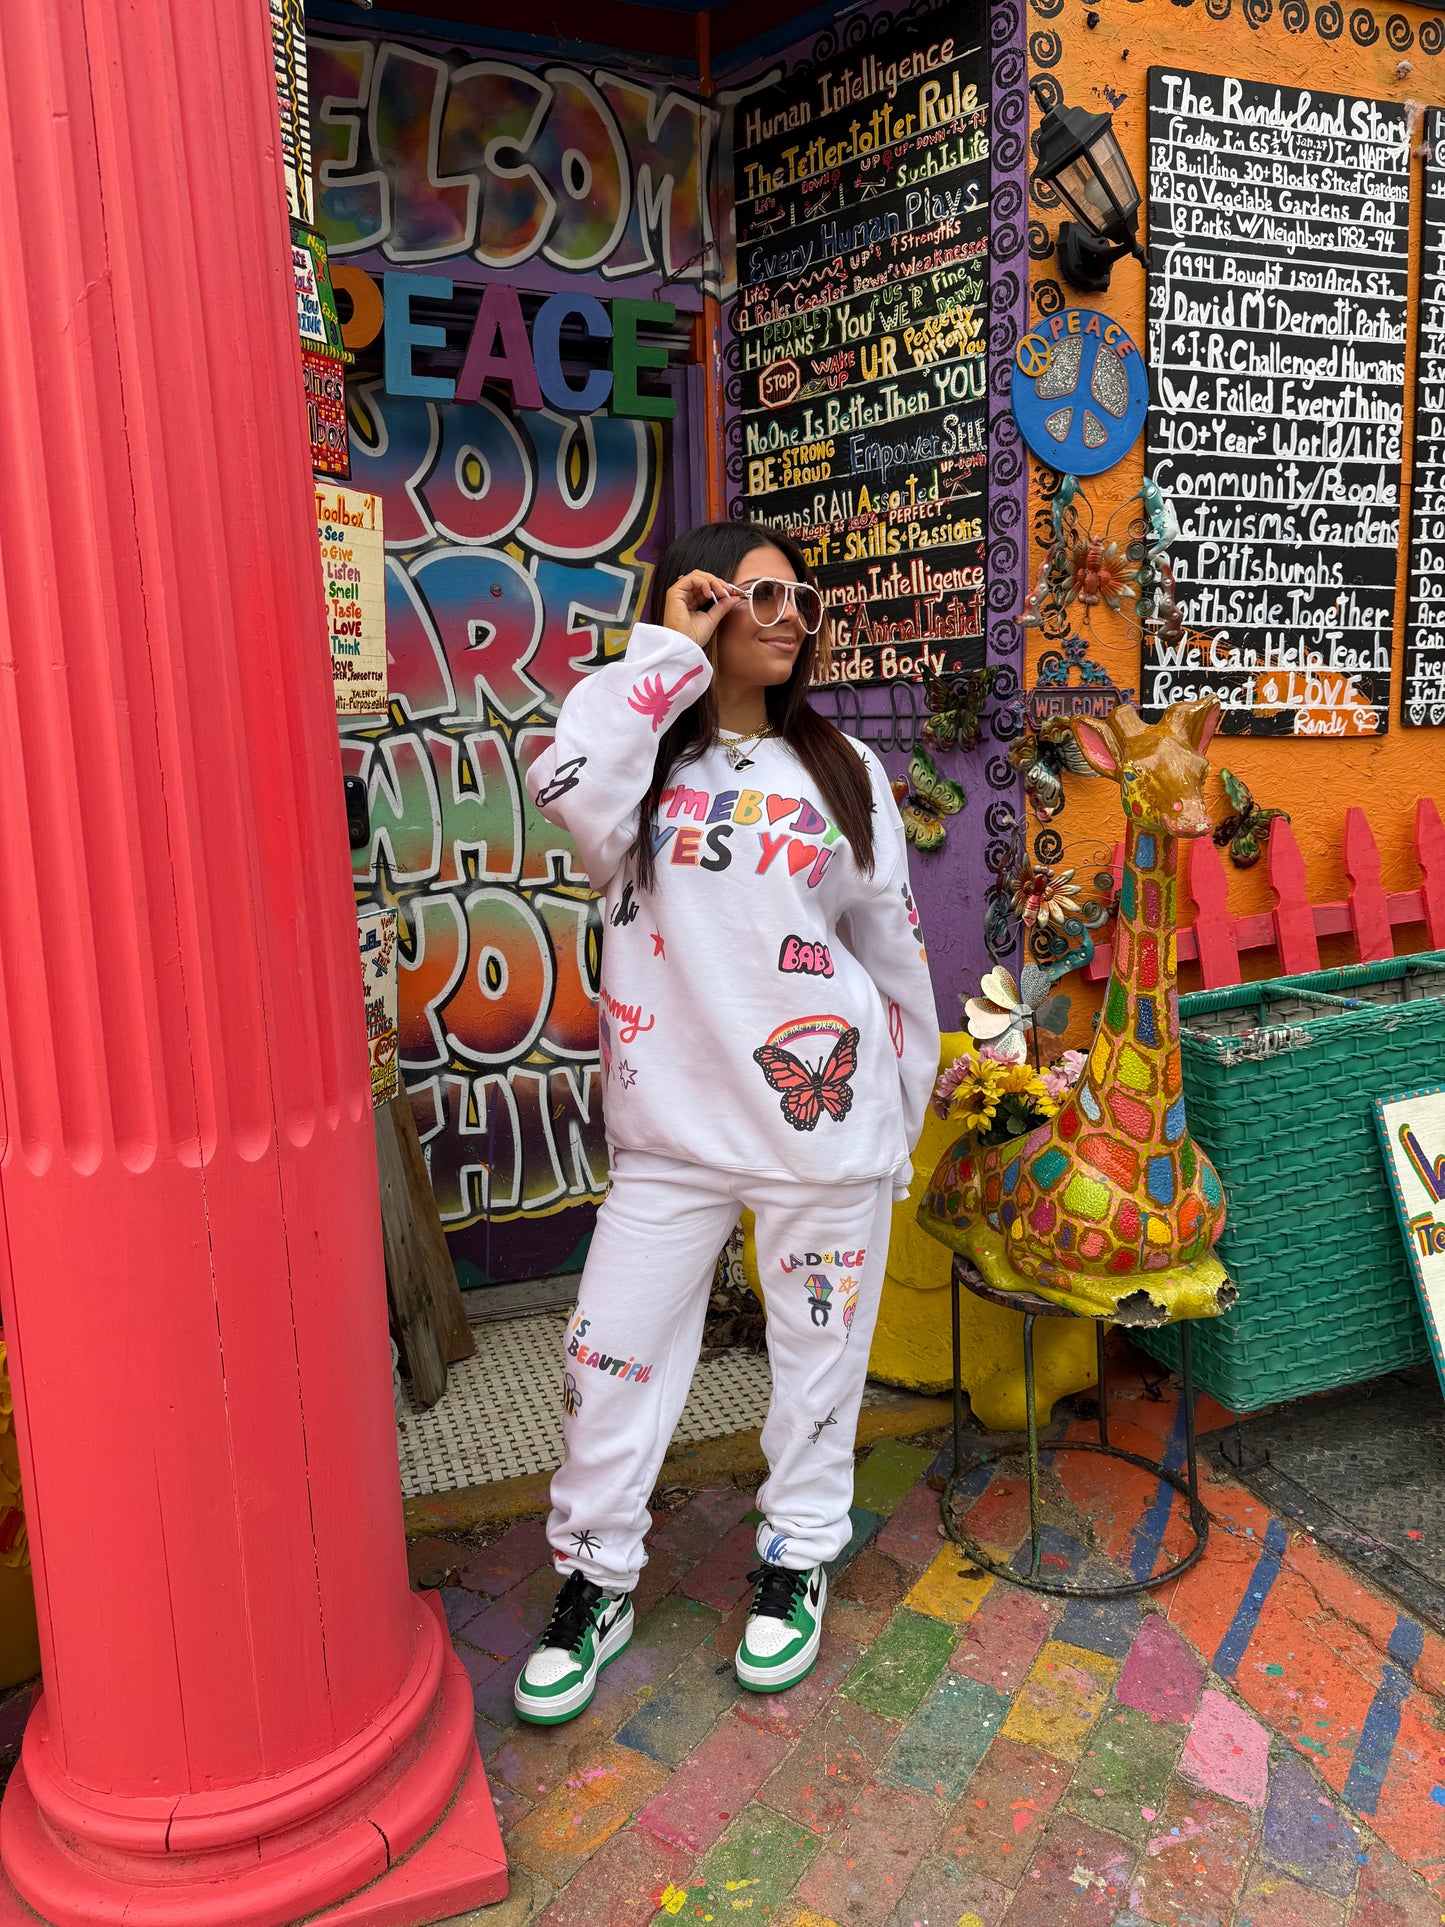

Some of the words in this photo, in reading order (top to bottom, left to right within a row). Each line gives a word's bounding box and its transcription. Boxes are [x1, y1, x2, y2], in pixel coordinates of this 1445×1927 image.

[744, 107, 811, 149] Human
[817, 37, 955, 117] Intelligence
[1162, 75, 1214, 116] The
[1223, 77, 1344, 143] Randyland
[1350, 100, 1411, 145] Story
[744, 160, 784, 200] The
[919, 70, 978, 131] Rule
[959, 130, 989, 165] Life
[1175, 122, 1219, 151] Today
[1177, 151, 1238, 183] Building
[1244, 163, 1271, 179] 30+
[1273, 163, 1317, 189] Blocks
[1322, 170, 1364, 195] Street
[1364, 173, 1408, 200] Gardens
[1175, 182, 1198, 201] 50
[1201, 177, 1273, 217] Vegetable
[1279, 191, 1349, 220] Gardens
[1360, 201, 1396, 226] And
[306, 233, 328, 263] Nose
[821, 212, 899, 257] Human
[1175, 207, 1187, 230] 8
[1191, 209, 1232, 236] Parks
[1338, 226, 1396, 252] 1982-94
[293, 250, 307, 268] SE
[1174, 254, 1214, 278] 1994
[1223, 259, 1283, 292] Bought
[1290, 270, 1323, 287] 1501
[1325, 269, 1362, 294] Arch
[1366, 274, 1395, 297] St.
[297, 312, 322, 335] INK
[1174, 290, 1235, 329] David
[1050, 311, 1135, 359] PEACE
[765, 371, 796, 395] STOP
[811, 350, 855, 376] WAKE
[1341, 347, 1405, 382] Humans
[880, 383, 930, 423] Then
[934, 358, 987, 406] YOU
[1163, 375, 1209, 410] We
[1216, 377, 1273, 414] Failed
[1282, 380, 1403, 436] Everything
[749, 456, 777, 497] BE
[782, 439, 835, 470] STRONG
[783, 463, 831, 488] PROUD
[324, 525, 344, 542] See
[844, 522, 901, 561] Skills
[907, 514, 982, 550] Passions
[1309, 507, 1399, 546] Gardens
[327, 561, 360, 583] Listen
[330, 545, 353, 562] Give
[1199, 542, 1343, 601] Pittsburghs
[329, 581, 359, 600] Smell
[820, 576, 868, 609] uman
[867, 557, 985, 602] Intelligence
[332, 599, 362, 619] Taste
[333, 618, 362, 638] LOVE
[1287, 589, 1390, 644] Together
[331, 635, 360, 656] Think
[1155, 631, 1200, 668] We
[1211, 631, 1257, 669] Can
[1265, 632, 1323, 682] Help
[1326, 631, 1389, 670] Teach
[813, 647, 875, 686] side
[1034, 696, 1115, 718] WELCOME
[1287, 672, 1363, 707] LOVE
[1293, 710, 1347, 737] Randy
[341, 728, 605, 890] WHA
[778, 934, 835, 979] BABY
[816, 1020, 842, 1034] DREAM
